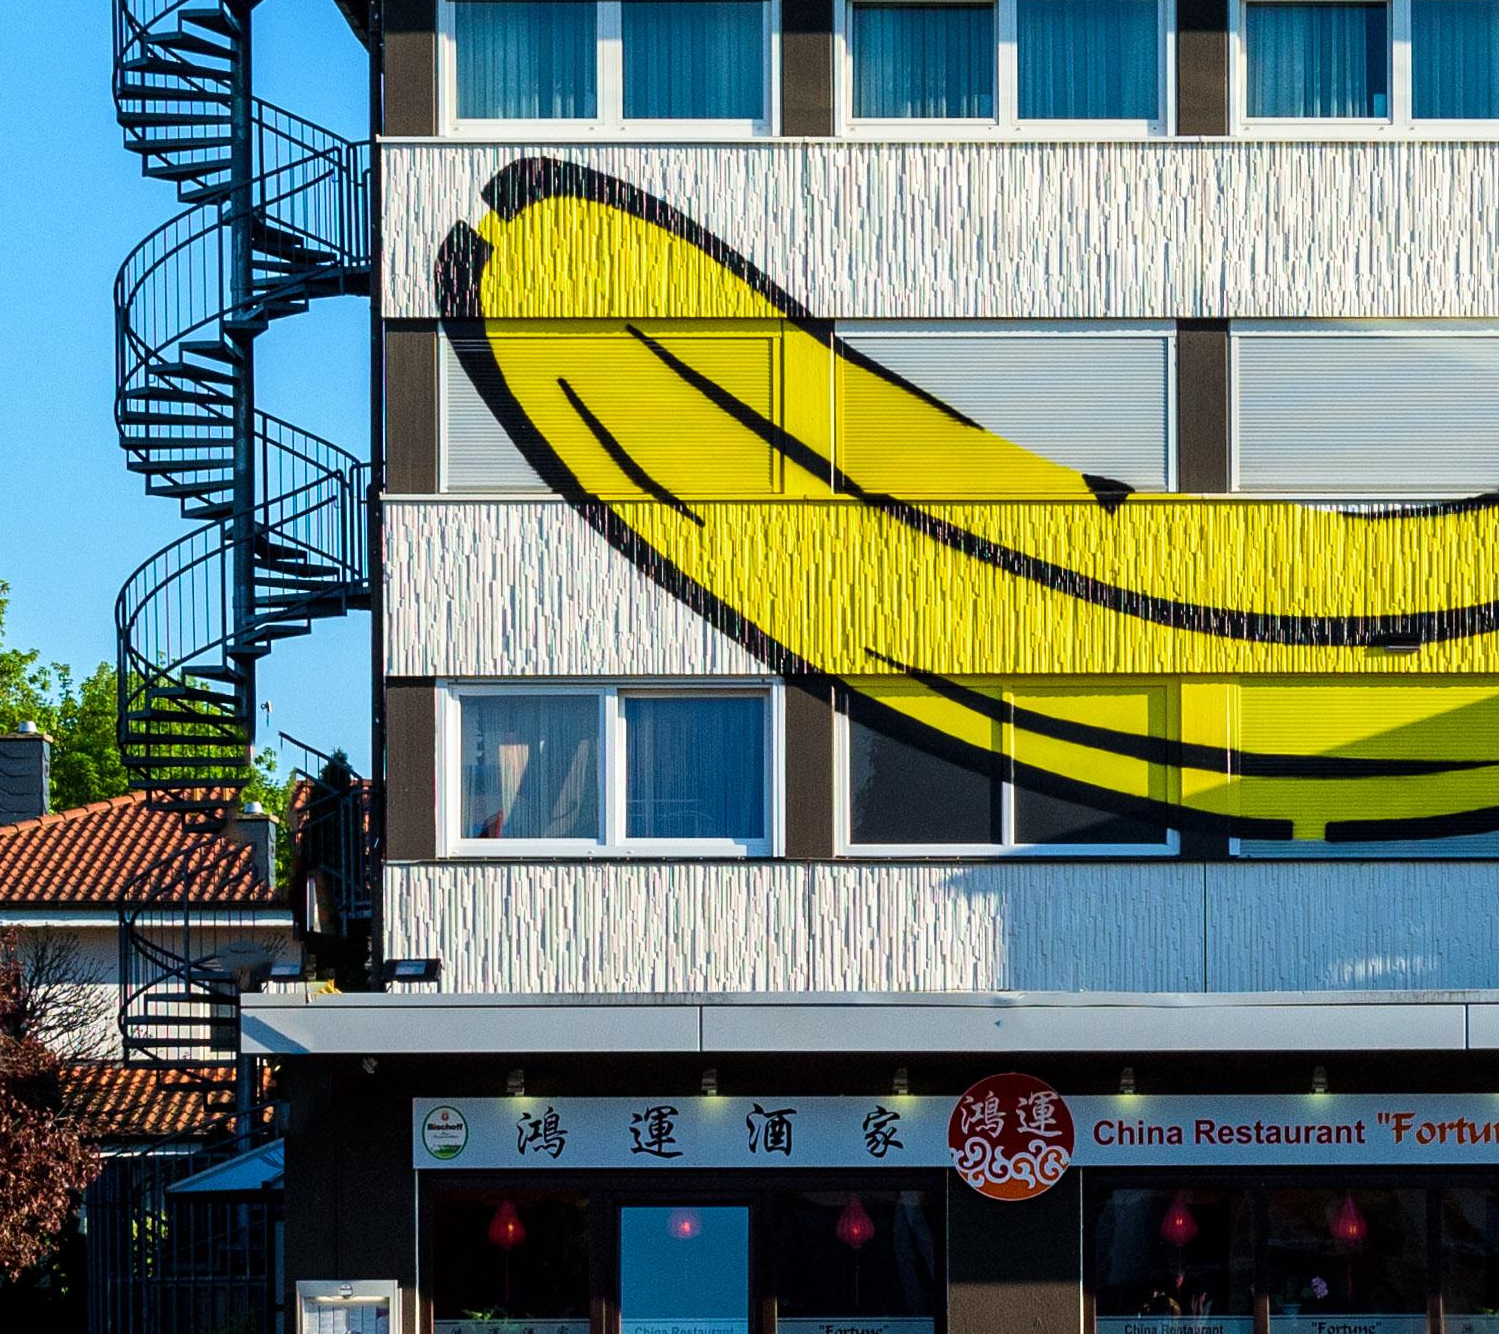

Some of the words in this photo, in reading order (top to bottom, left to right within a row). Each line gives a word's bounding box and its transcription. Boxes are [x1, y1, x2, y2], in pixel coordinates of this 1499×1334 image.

[960, 1090, 1064, 1138] 鴻運
[1093, 1119, 1183, 1147] China
[1195, 1119, 1365, 1146] Restaurant
